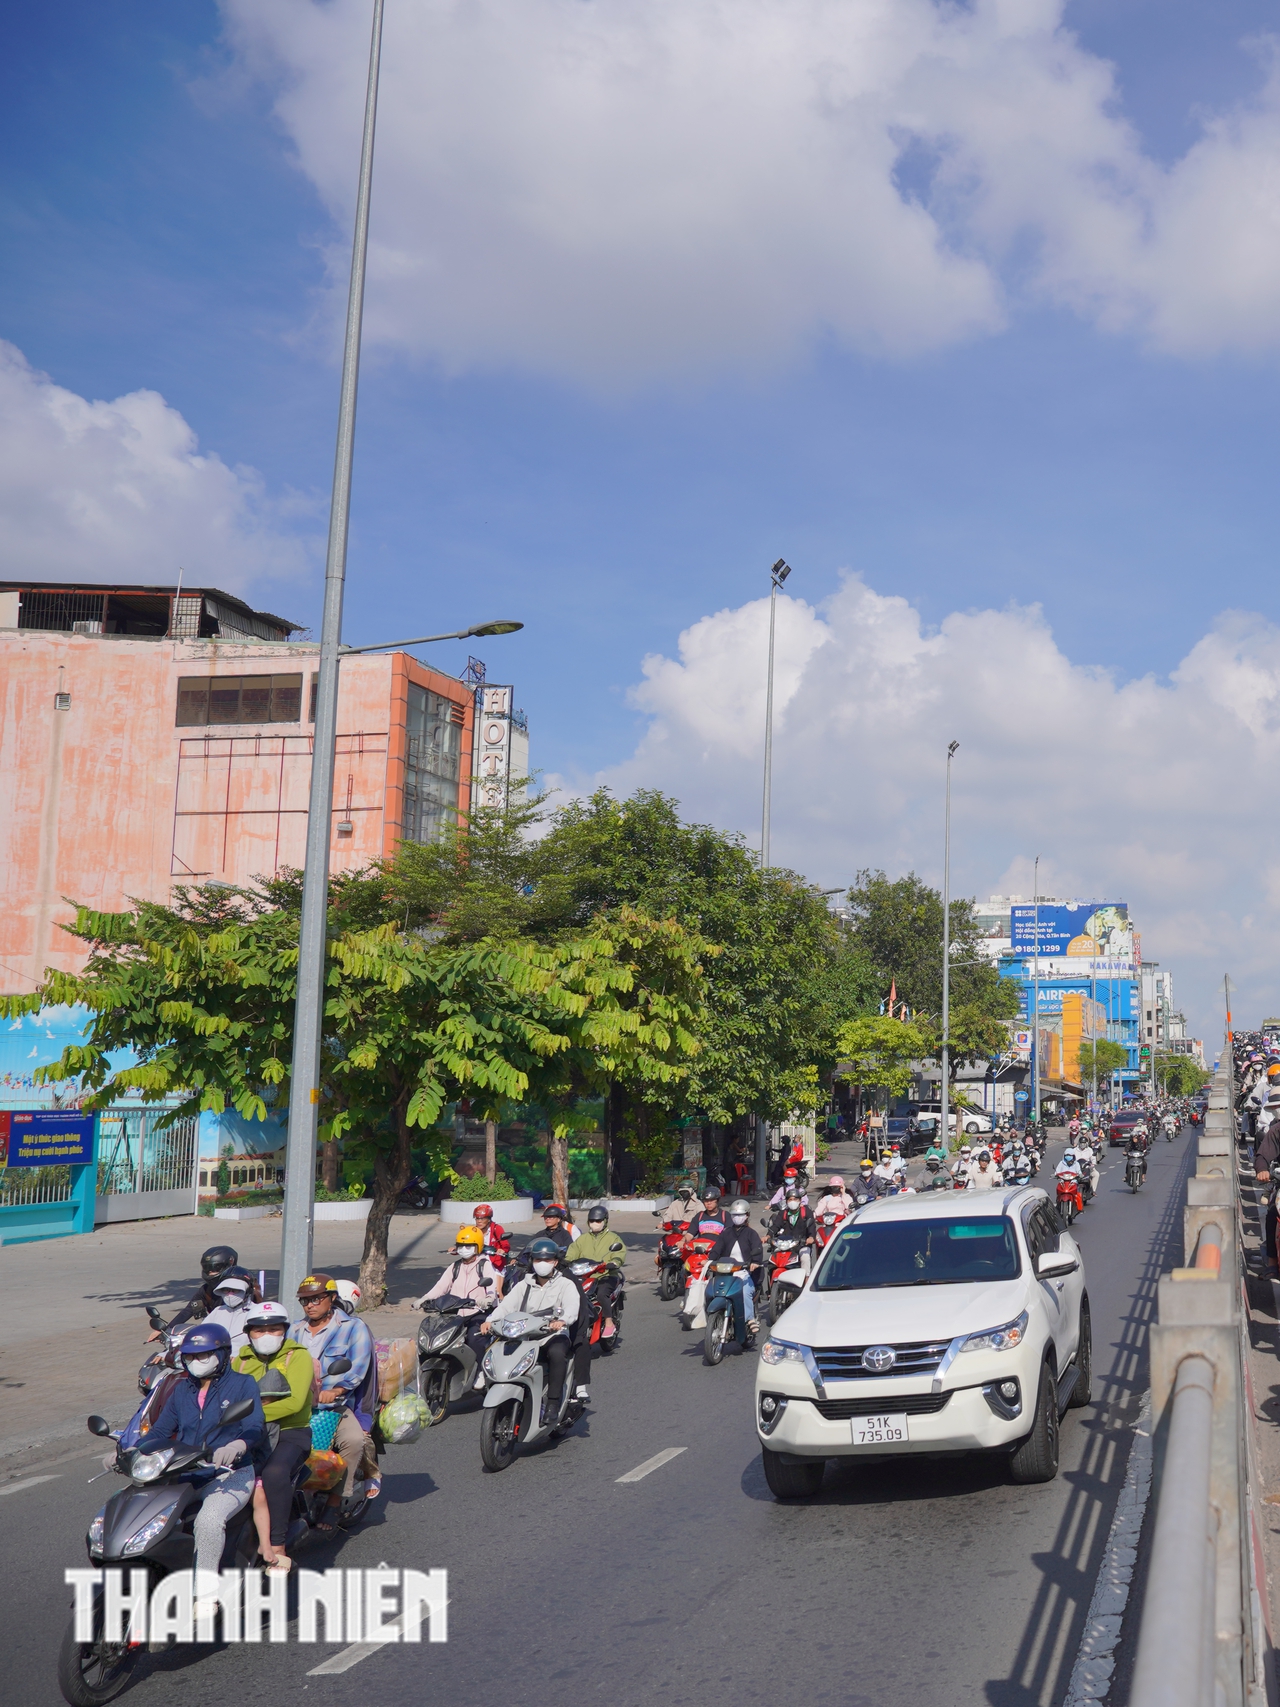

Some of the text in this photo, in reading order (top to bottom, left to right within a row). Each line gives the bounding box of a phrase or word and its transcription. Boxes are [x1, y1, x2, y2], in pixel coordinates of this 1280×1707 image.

[481, 689, 509, 822] HOTE
[1042, 944, 1061, 952] 1299
[867, 1416, 891, 1430] 51K
[859, 1428, 902, 1443] 735.09
